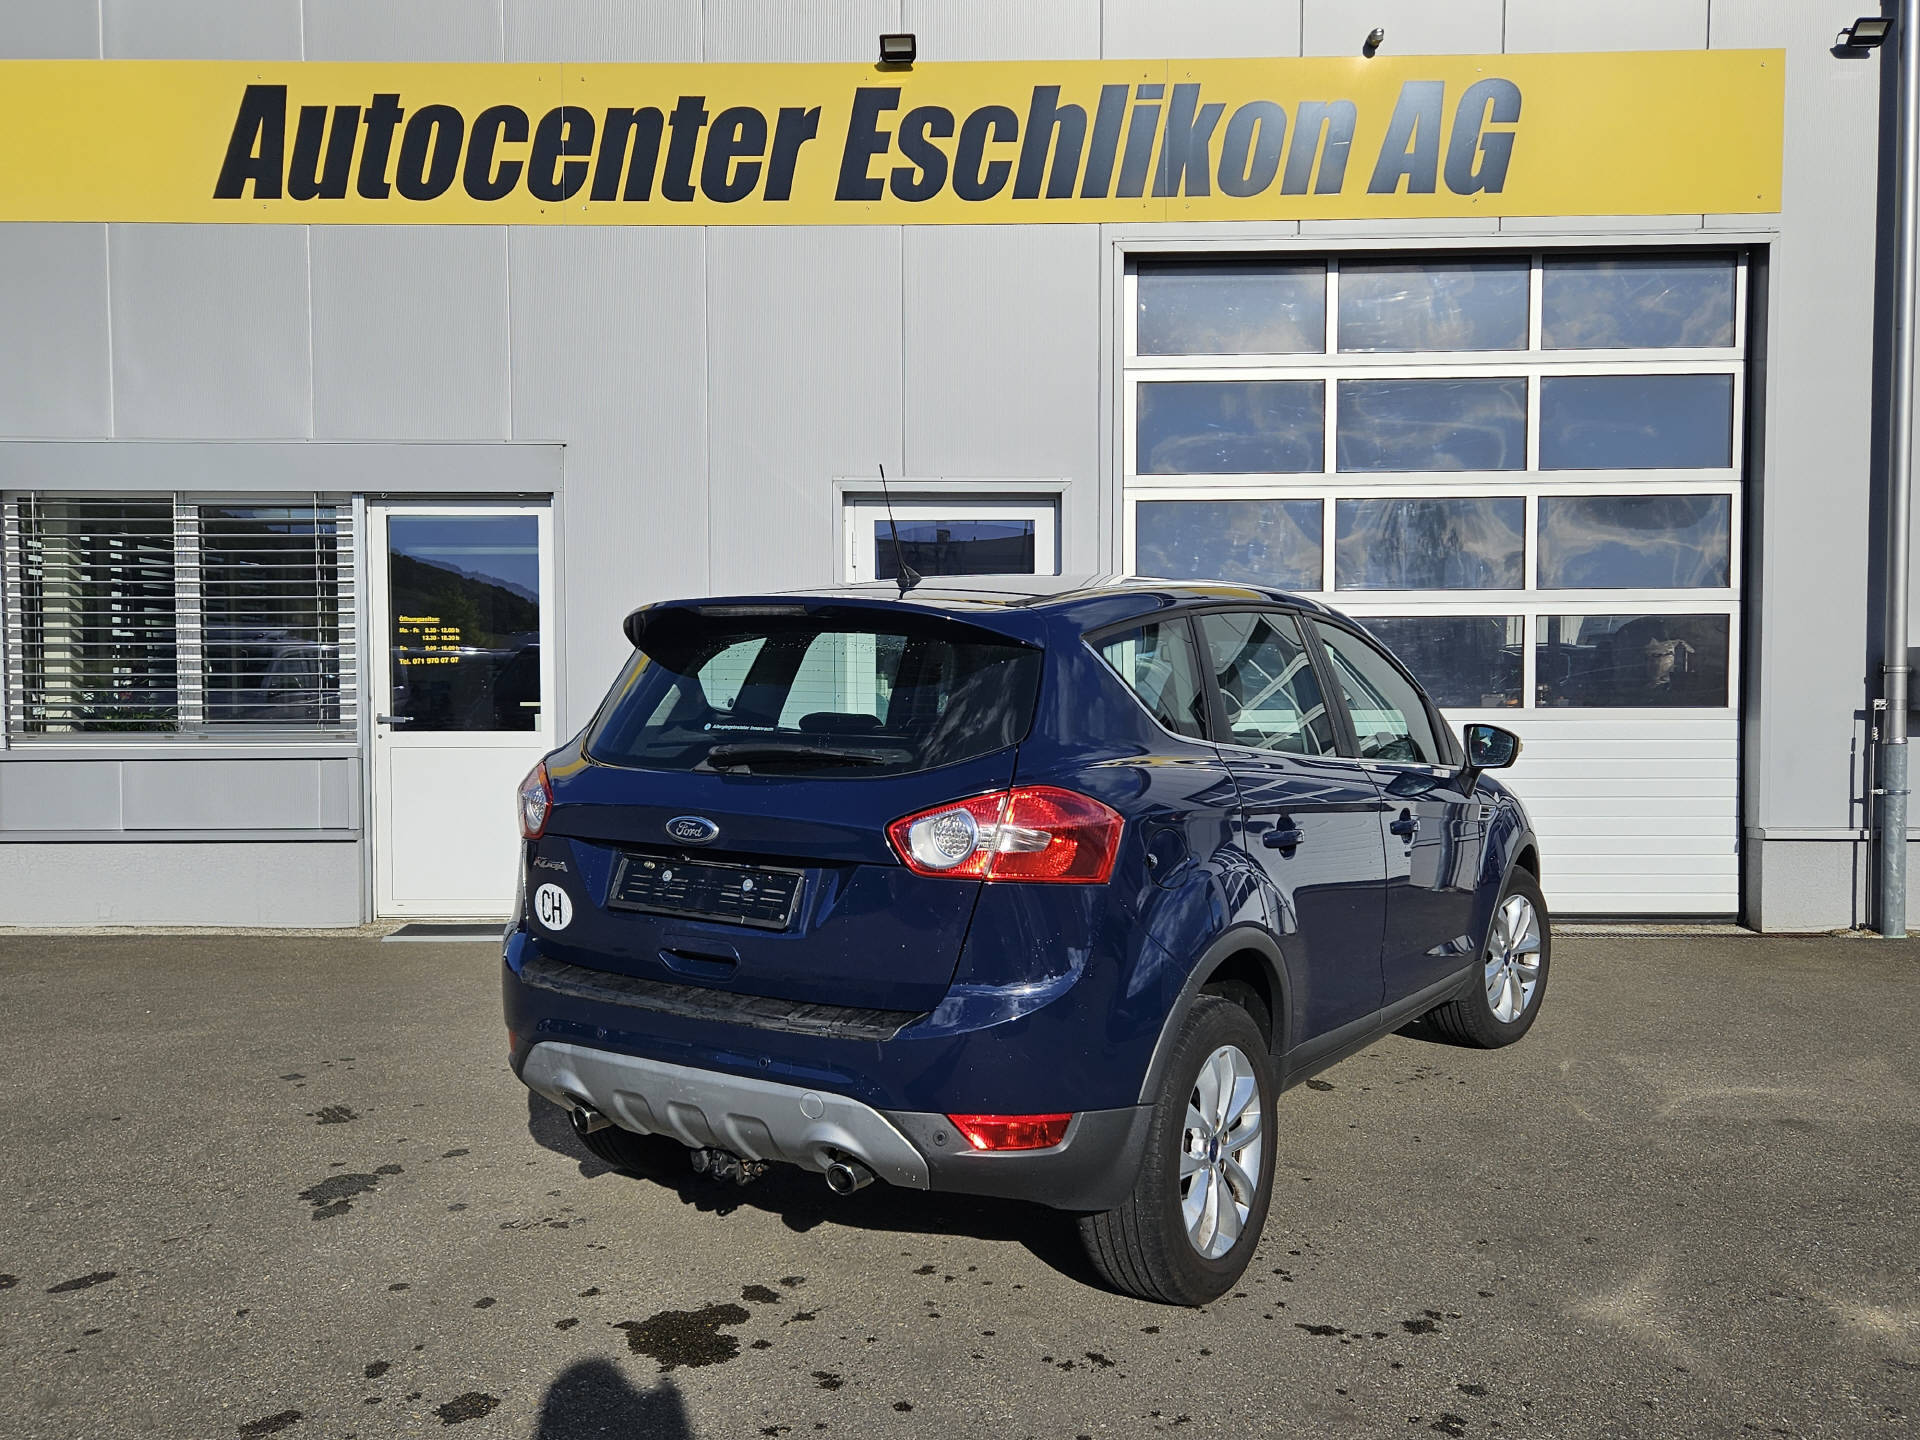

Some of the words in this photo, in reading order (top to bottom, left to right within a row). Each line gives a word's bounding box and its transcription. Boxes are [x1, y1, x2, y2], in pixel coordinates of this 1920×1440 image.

[213, 84, 822, 203] Autocenter
[834, 83, 1357, 201] Eschlikon
[1366, 78, 1523, 195] AG
[675, 820, 703, 837] Ford
[542, 889, 563, 925] CH
